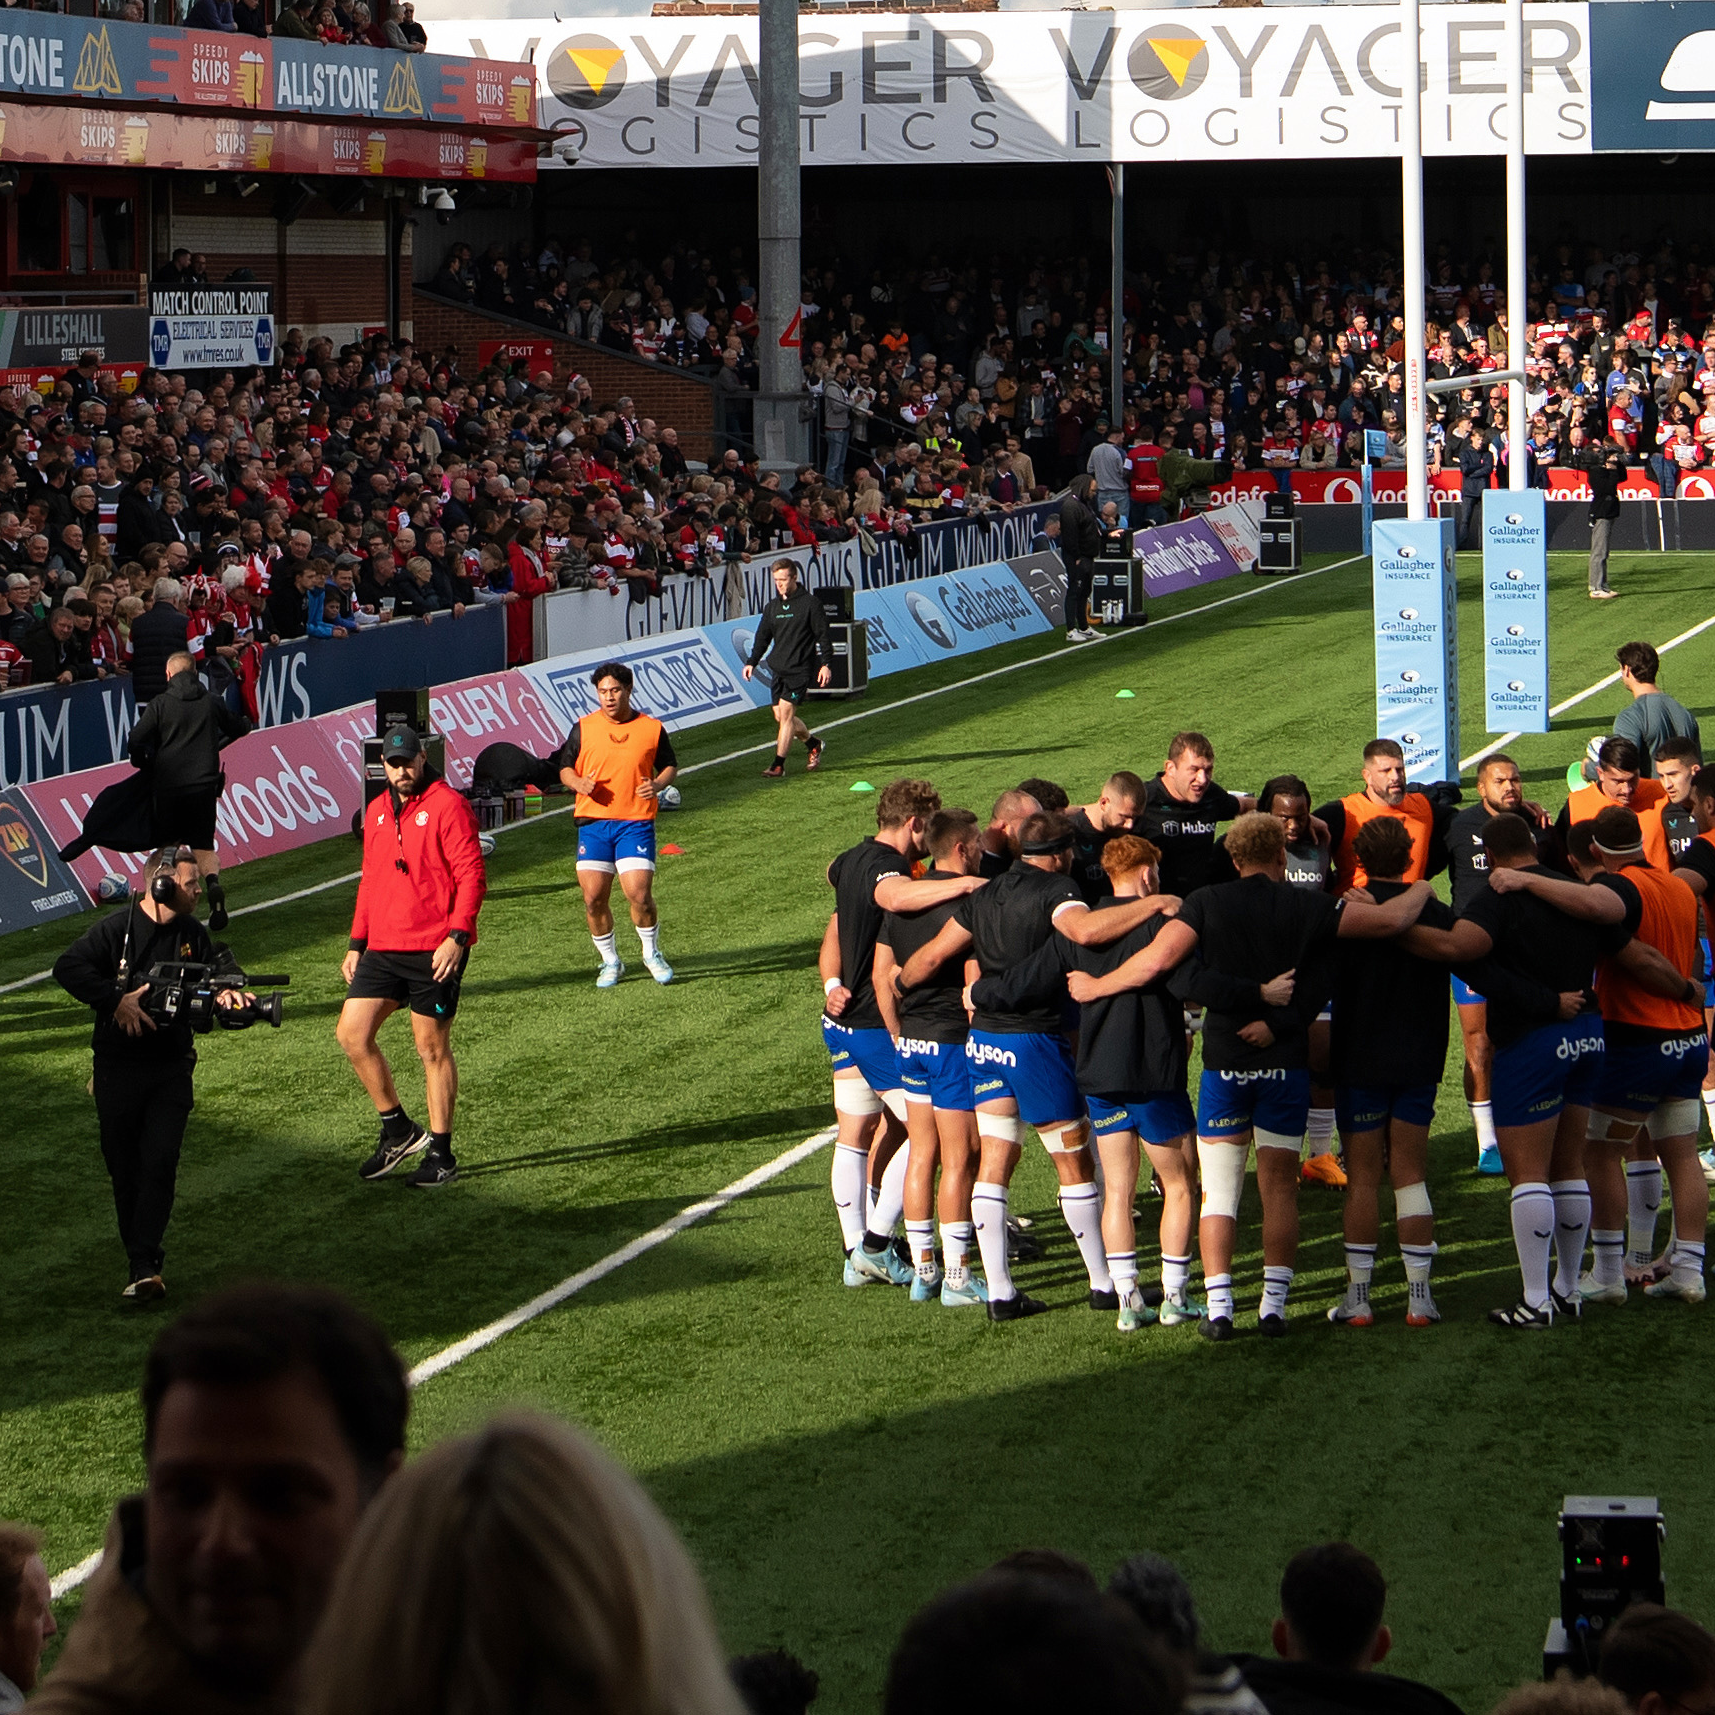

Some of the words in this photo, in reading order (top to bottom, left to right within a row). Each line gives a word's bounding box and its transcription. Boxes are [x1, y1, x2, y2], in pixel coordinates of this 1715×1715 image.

[191, 58, 230, 86] SKIPS
[277, 60, 379, 111] ALLSTONE
[476, 82, 504, 107] SKIPS
[80, 126, 115, 149] SKIPS
[215, 133, 246, 155] SKIPS
[333, 140, 361, 161] SKIPS
[152, 291, 190, 316] MATCH
[191, 290, 238, 316] CONTROL
[239, 290, 270, 315] POINT
[24, 313, 106, 347] LILLESHALL
[172, 321, 218, 340] ELECTRICAL
[219, 320, 254, 340] SERVICES
[508, 345, 534, 358] EXIT
[1489, 526, 1540, 539] Gallagher
[1493, 537, 1536, 545] INSURANCE
[1380, 560, 1435, 572] Gallagher
[1385, 572, 1431, 580] INSURANCE
[1489, 581, 1541, 593] Gallagher
[938, 578, 1033, 632] Gallagher
[1381, 622, 1437, 634] Gallagher
[1490, 637, 1542, 649] Gallagher
[635, 648, 735, 712] CONTROLS
[1382, 684, 1439, 696] Gallagher
[1490, 692, 1542, 705] Gallagher
[31, 889, 79, 913] FIRELIGHTERS
[965, 1036, 1016, 1067] dyson
[1557, 1037, 1605, 1062] dyson
